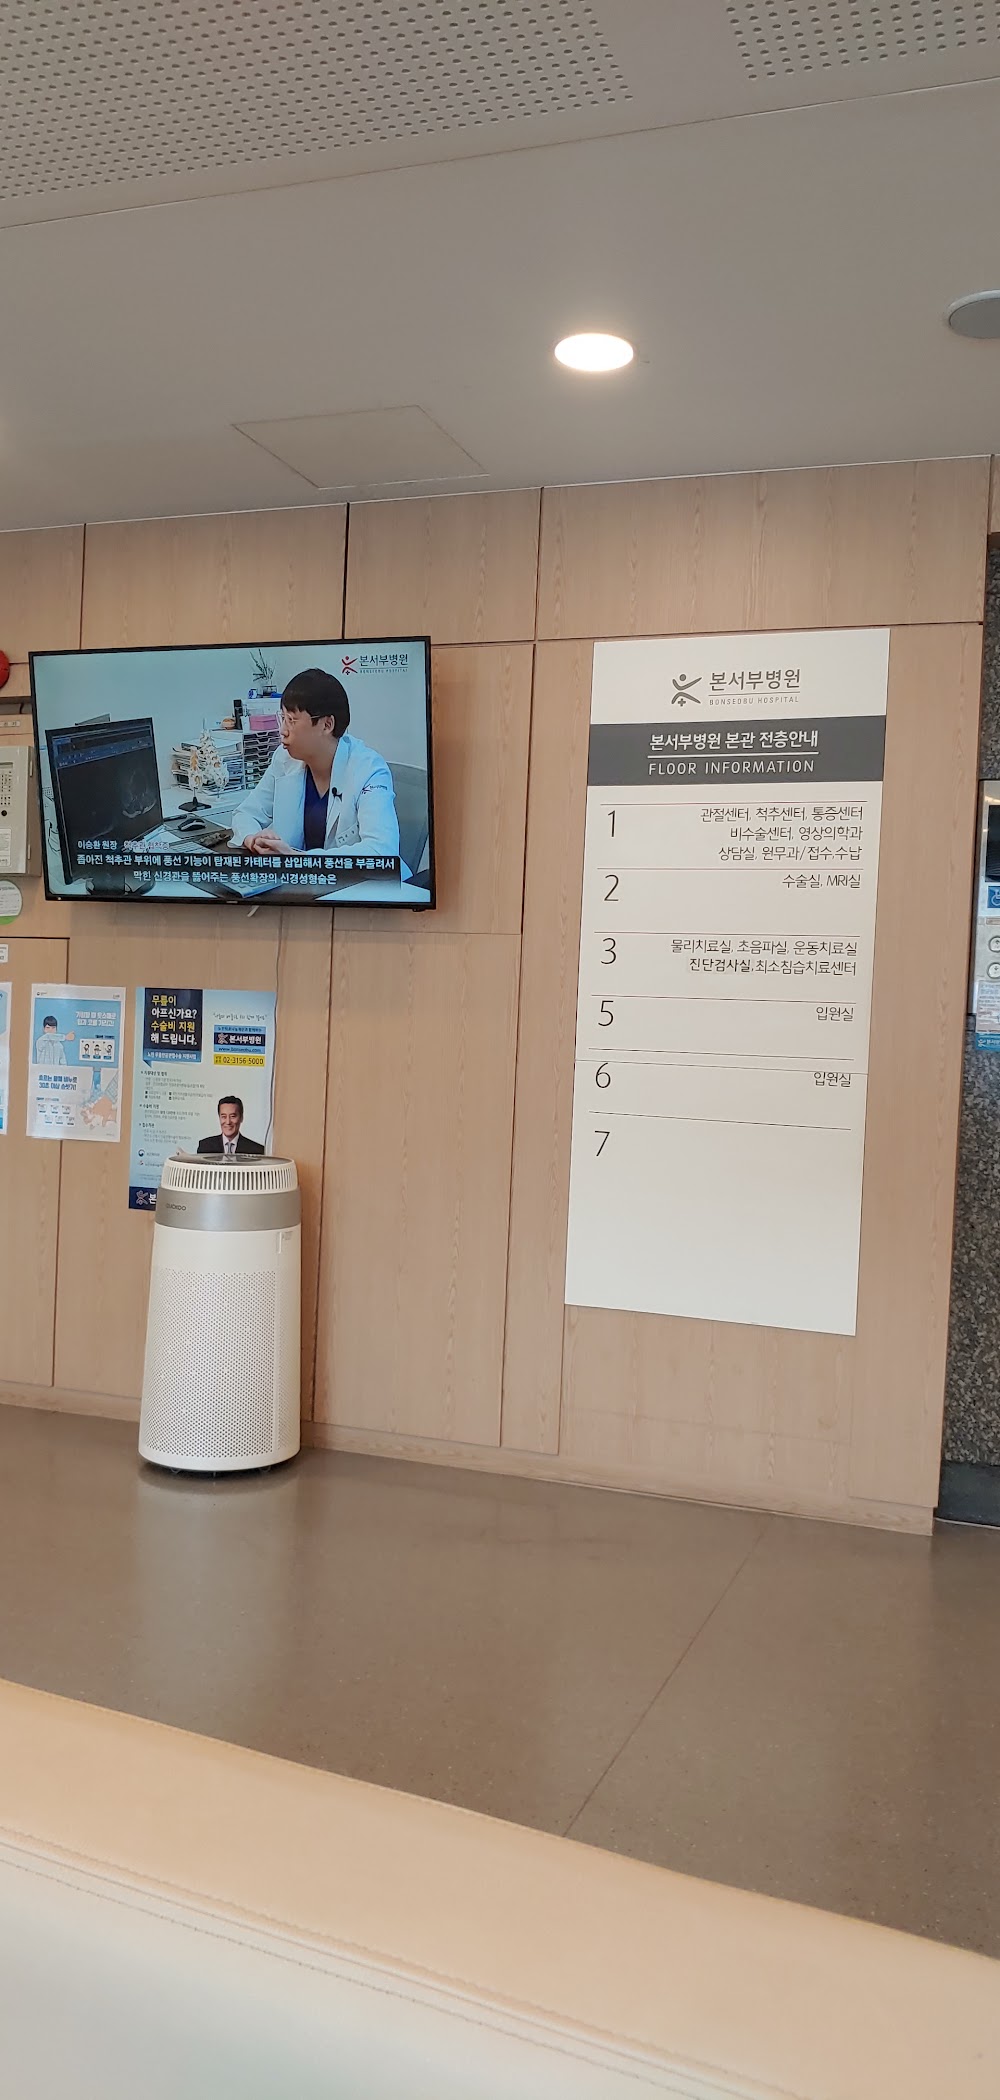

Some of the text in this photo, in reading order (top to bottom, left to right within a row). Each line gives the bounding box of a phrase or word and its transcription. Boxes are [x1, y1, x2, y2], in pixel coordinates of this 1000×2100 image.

[359, 653, 408, 667] 본서부병원
[709, 668, 801, 692] 본서부병원
[709, 696, 799, 706] BONSEOBU HOSPITAL
[649, 730, 818, 751] 본서부병원 본관 전층안내
[648, 759, 815, 775] FLOOR INFORMATION
[700, 806, 863, 823] 관절센터, 척추센터, 통증센터
[606, 809, 617, 838] 1
[730, 826, 863, 842] 비수술센터, 영상의학과
[77, 840, 101, 850] 이승환
[101, 840, 118, 850] 원장
[718, 846, 758, 861] 상담실,
[77, 854, 395, 870] 좁아진 척추관 부위에 풍선 기능이 탑재된 카테터를 삽입해서 풍선을 부풀려서
[133, 870, 337, 885] 막힌 신경관을 뚫어주는 풍선확장의 신경성형술은
[782, 874, 861, 889] 수술실, MRI실
[603, 874, 620, 902] 2
[600, 937, 617, 964] 3
[670, 939, 858, 956] 물리치료실, 초음파실, 운동치료실
[151, 995, 176, 1007] 무릎이
[151, 1007, 198, 1019] 아프신가요?
[597, 1000, 614, 1026] 5
[815, 1006, 854, 1021] 입원실
[151, 1020, 195, 1033] 수술비 지원
[150, 1032, 198, 1045] 해 드립니다.
[229, 1034, 262, 1045] 본서부병원
[595, 1062, 611, 1088] 6
[813, 1072, 852, 1087] 입원실
[594, 1130, 611, 1157] 7
